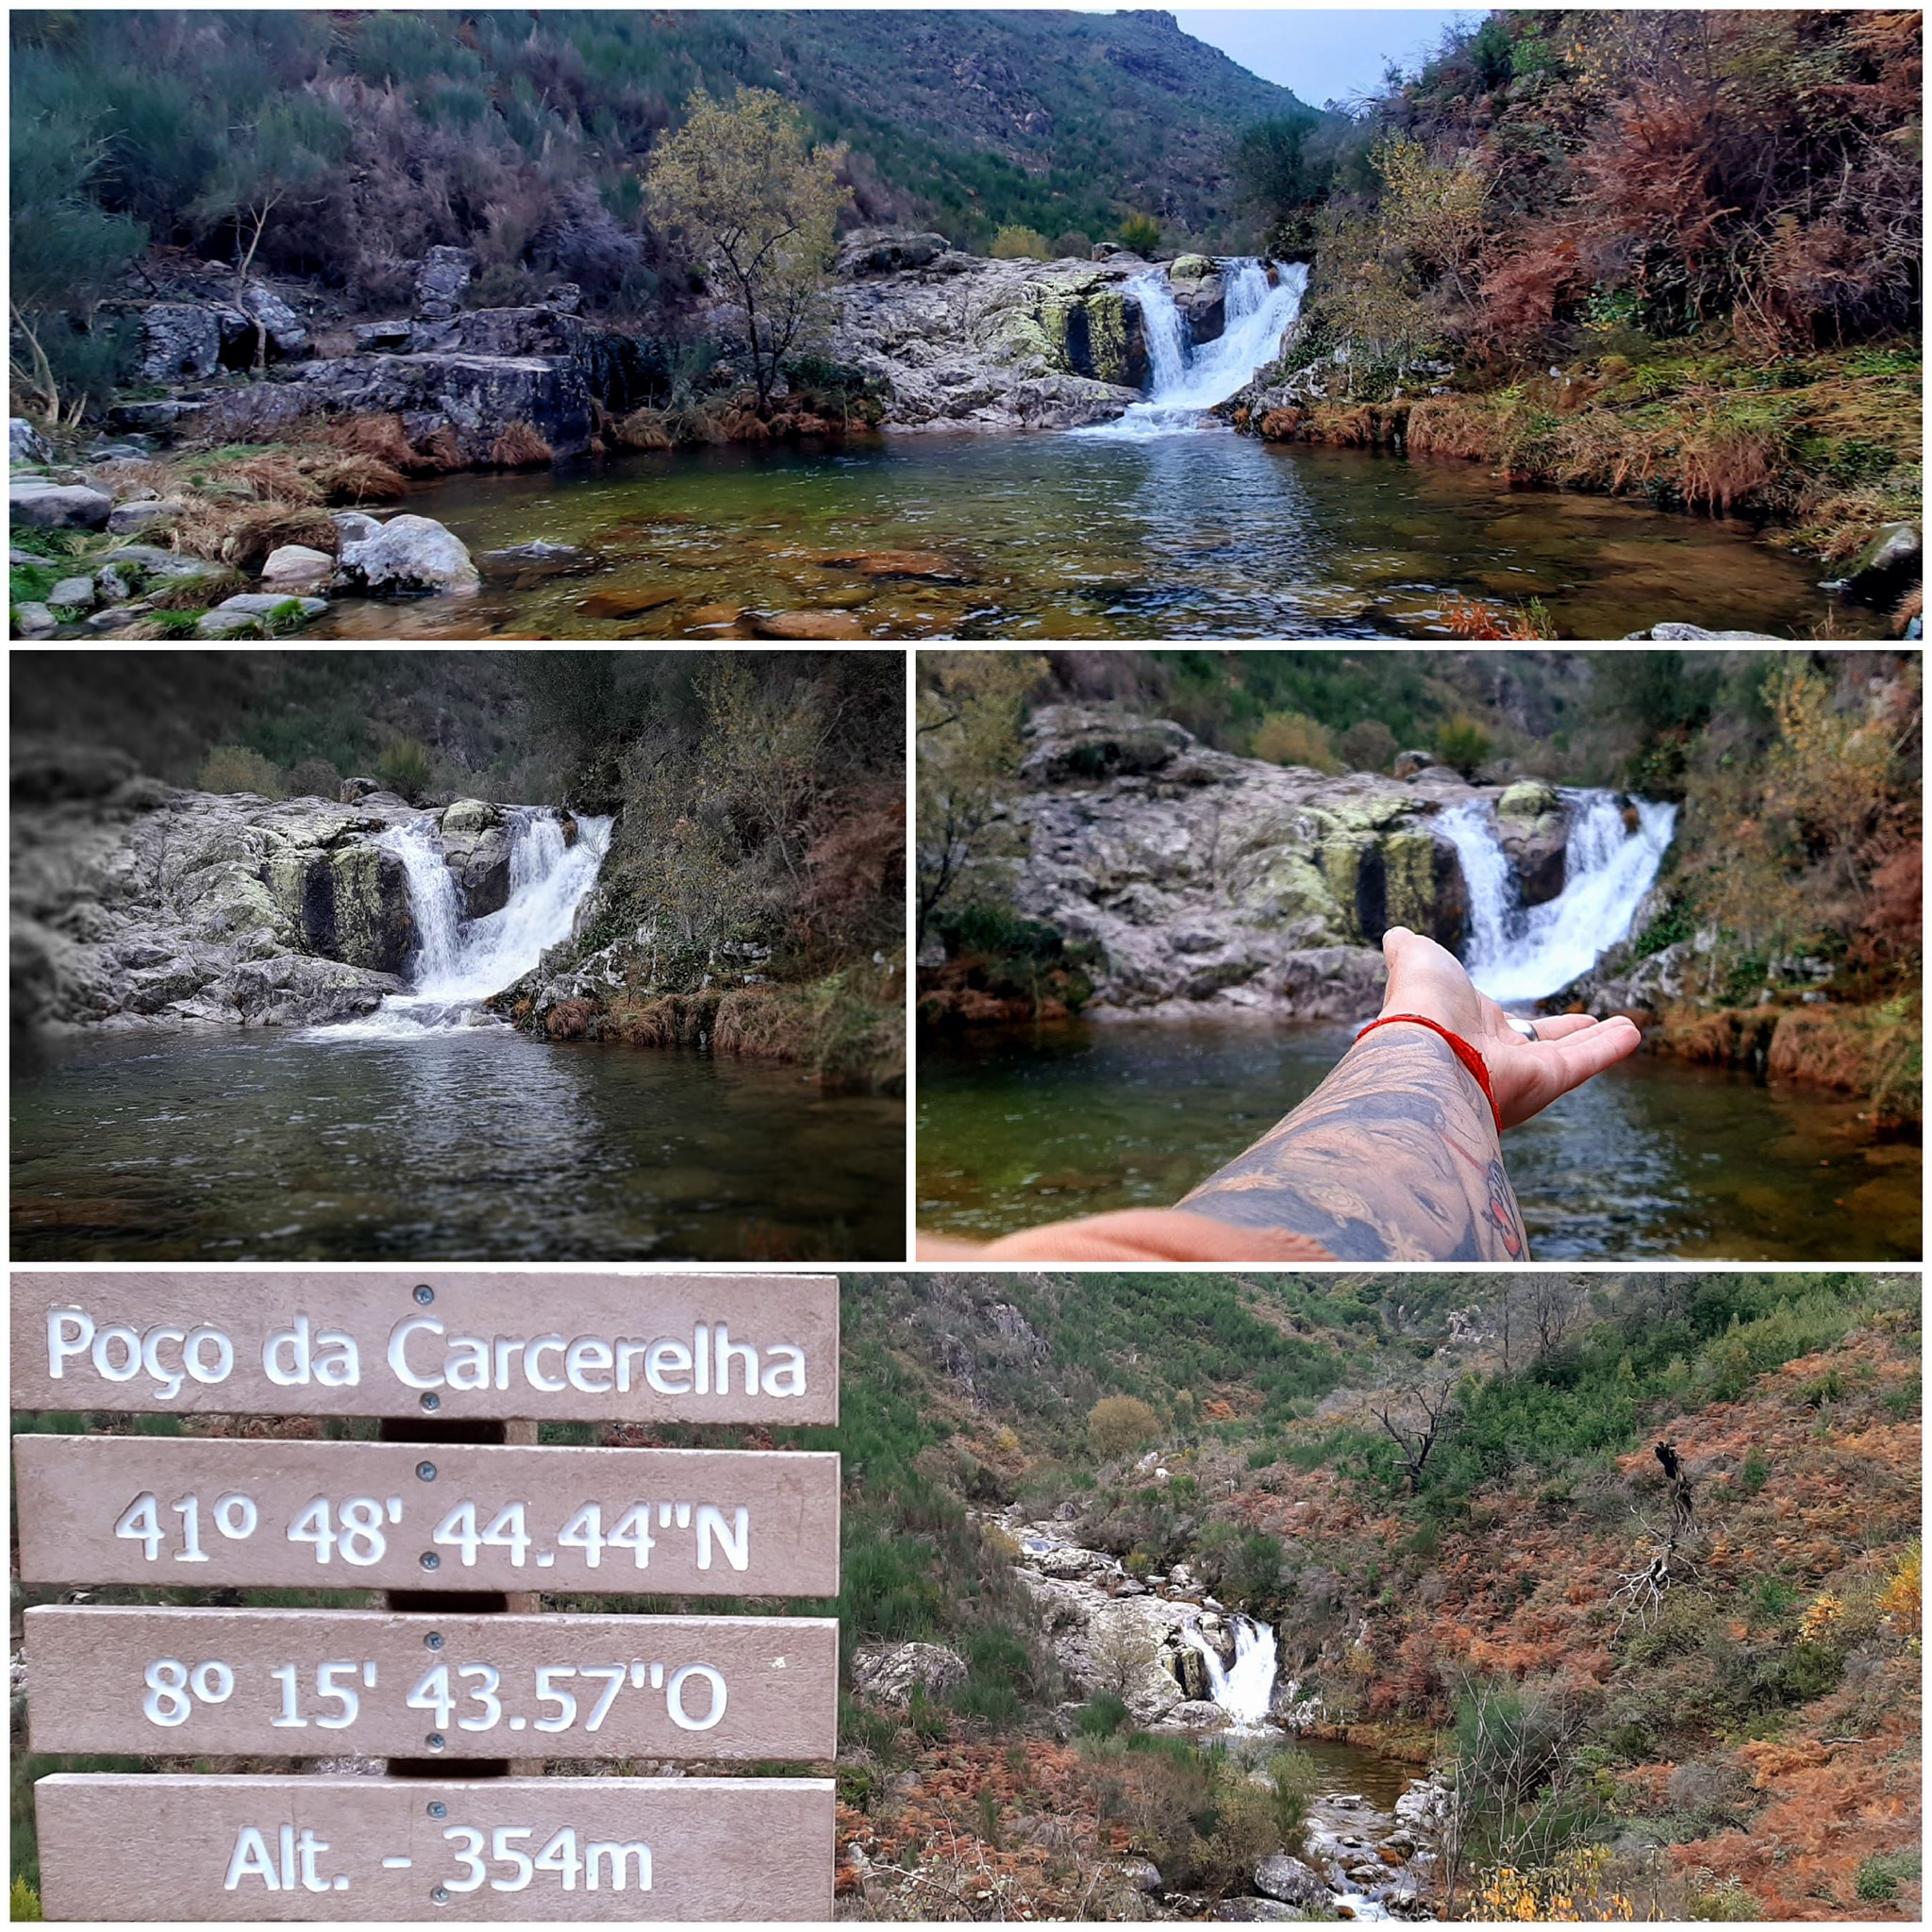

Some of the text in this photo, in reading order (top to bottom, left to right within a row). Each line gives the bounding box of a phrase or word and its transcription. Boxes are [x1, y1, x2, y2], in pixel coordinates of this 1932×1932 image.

[45, 1307, 808, 1401] Poço da Carcerelha
[286, 1494, 405, 1568] 48'
[268, 1660, 379, 1730] 15'
[223, 1824, 353, 1893] Alt.
[441, 1824, 655, 1893] 354m
